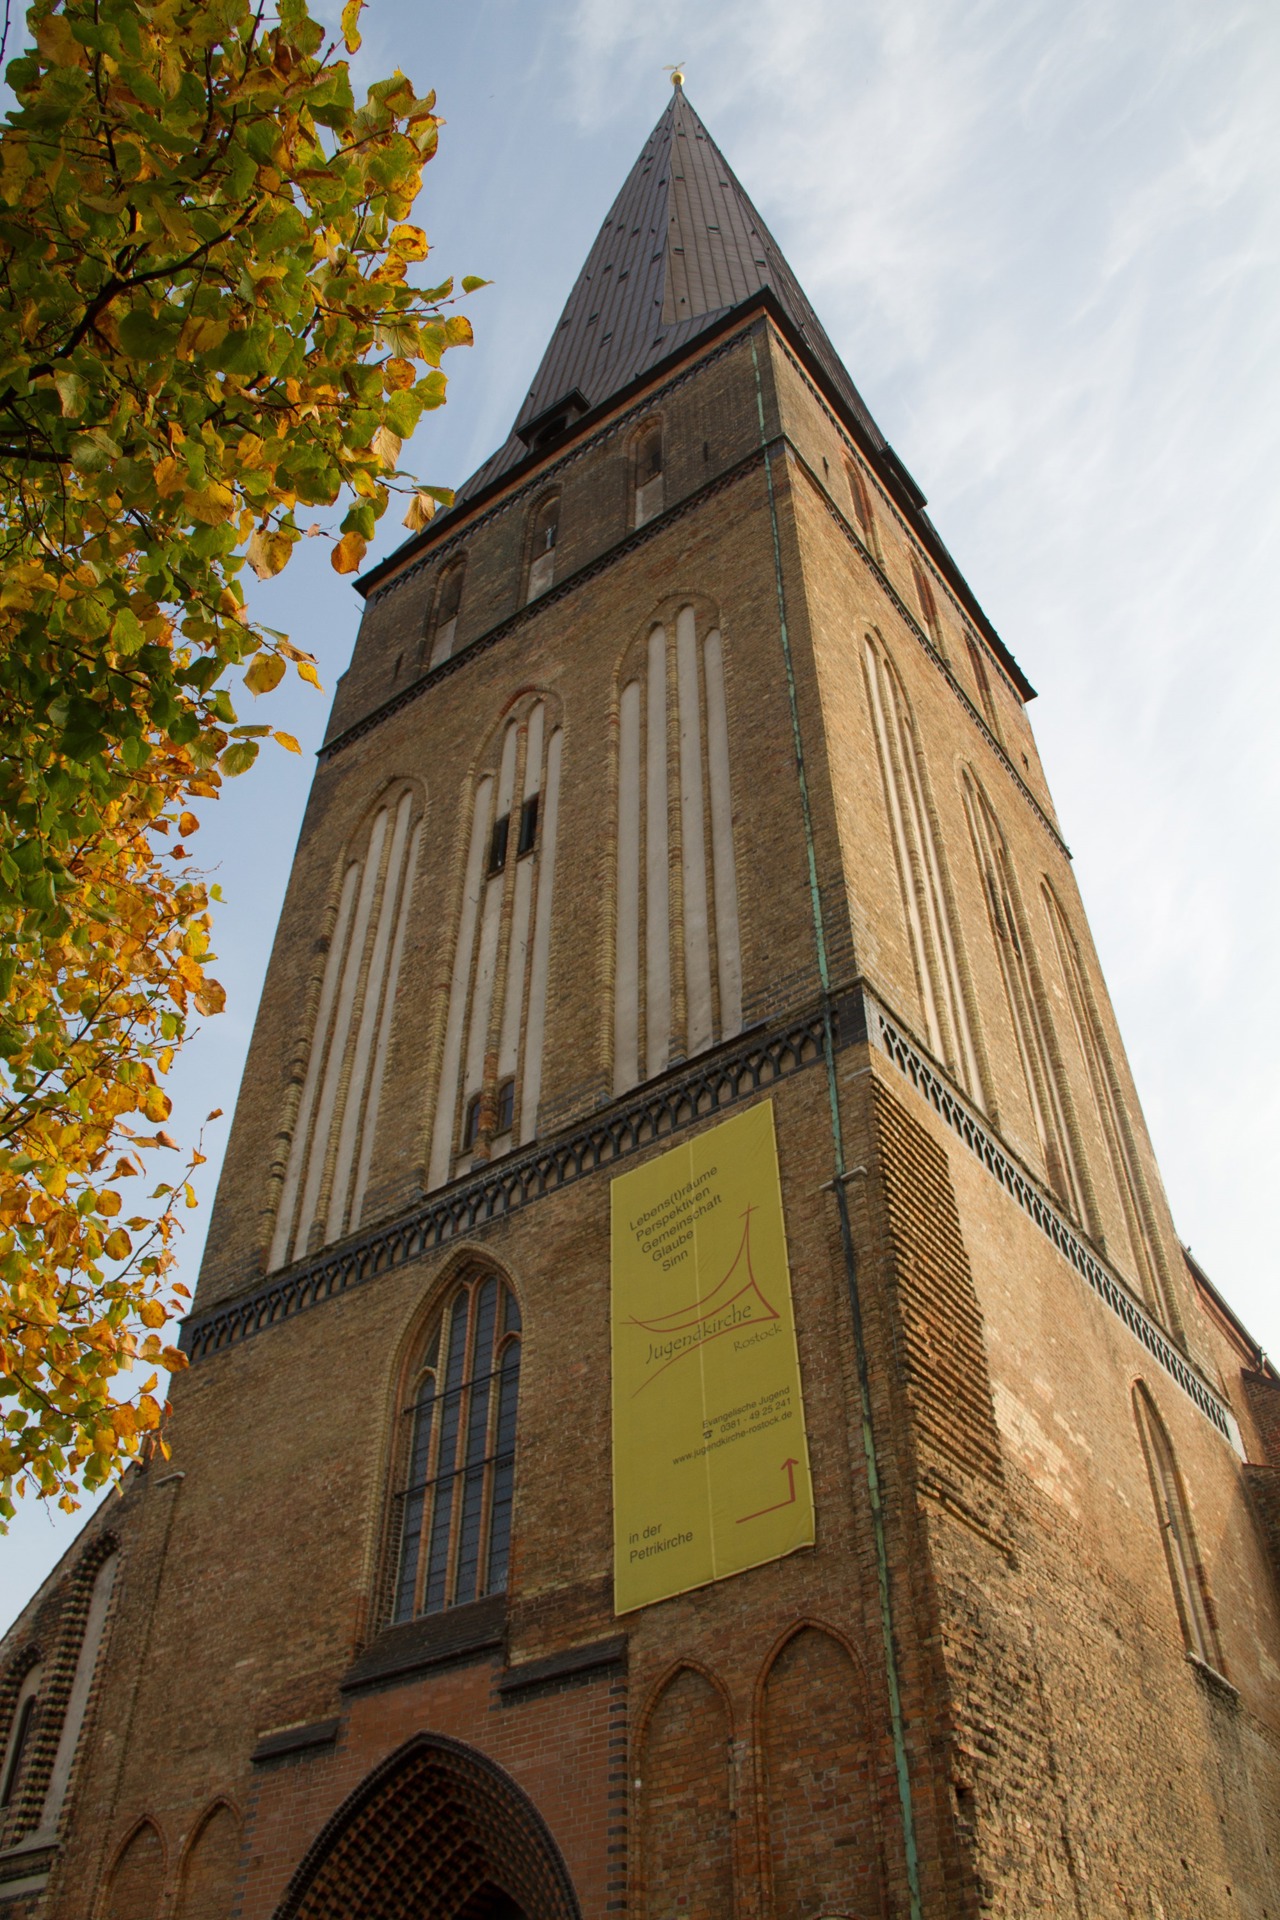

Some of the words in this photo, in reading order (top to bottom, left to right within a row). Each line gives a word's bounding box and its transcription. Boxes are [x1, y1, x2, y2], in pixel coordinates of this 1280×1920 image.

[629, 1166, 718, 1231] Lebens(t)räume
[635, 1187, 710, 1241] Perspektiven
[641, 1194, 722, 1253] Gemeinschaft
[652, 1230, 694, 1262] Glaube
[662, 1250, 688, 1272] Sinn
[646, 1304, 752, 1364] Jugendkirche
[733, 1323, 782, 1352] Rostock
[702, 1400, 757, 1429] Evangelische
[758, 1385, 790, 1406] Jugend
[720, 1418, 741, 1433] 0381
[749, 1410, 760, 1420] 49
[762, 1404, 774, 1416] 25
[775, 1397, 791, 1410] 241
[672, 1410, 793, 1465] www.jugendkirche-rostock.de
[629, 1532, 639, 1544] in
[642, 1523, 662, 1539] der
[629, 1531, 694, 1563] Petrikirche
